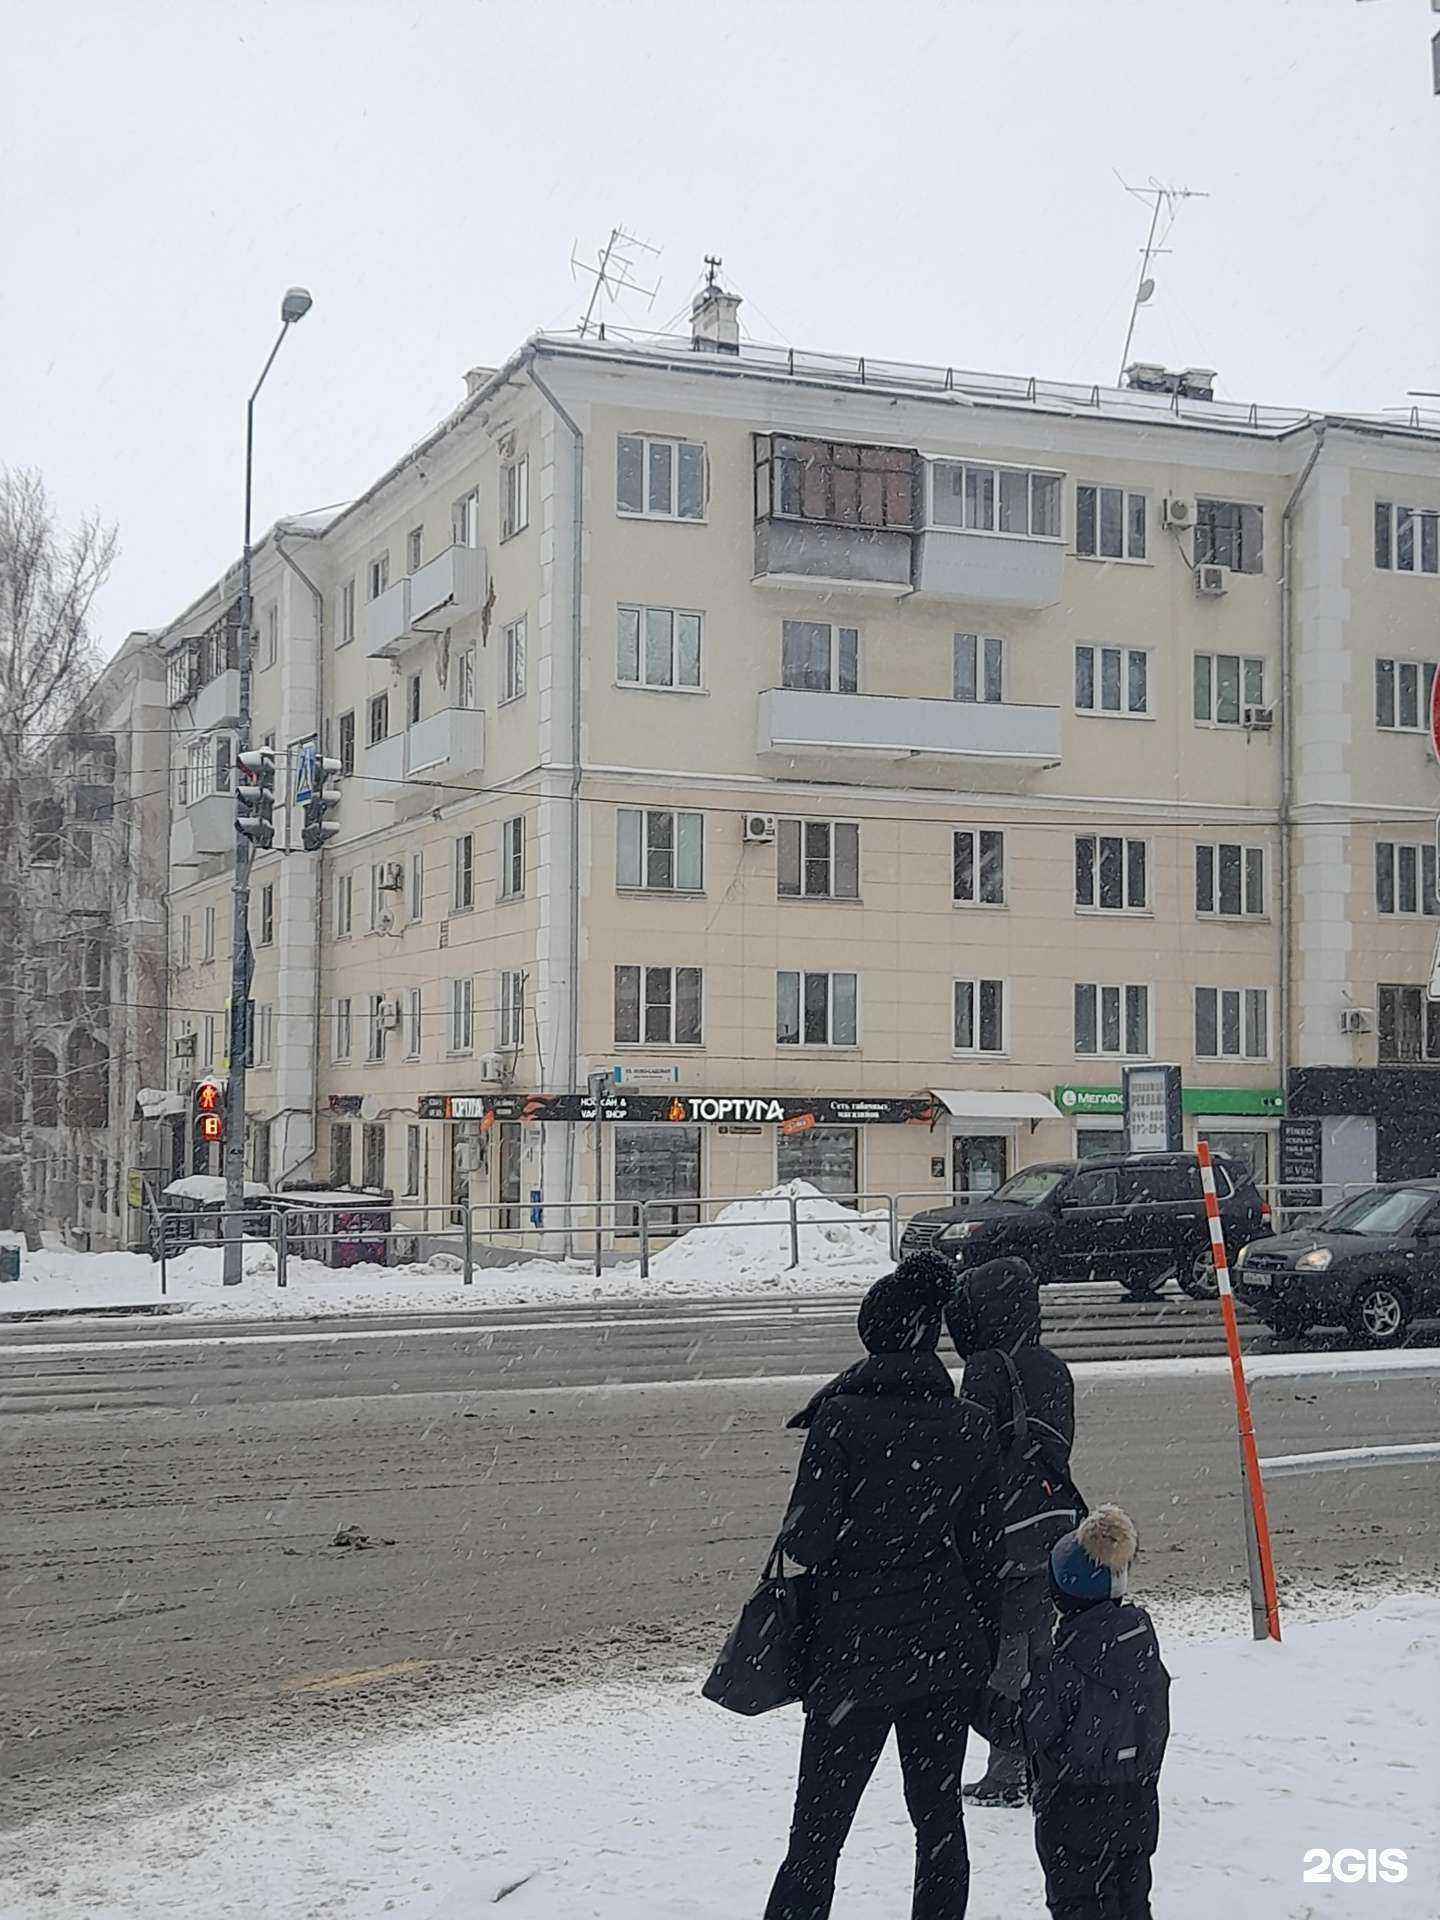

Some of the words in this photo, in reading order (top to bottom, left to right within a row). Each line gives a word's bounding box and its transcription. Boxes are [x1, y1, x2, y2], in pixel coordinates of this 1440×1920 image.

[620, 1098, 627, 1107] &
[1077, 1092, 1123, 1104] МЕГАФ
[581, 1109, 601, 1119] VAP
[605, 1109, 628, 1119] SHOP
[688, 1098, 785, 1121] ТОРТУГА
